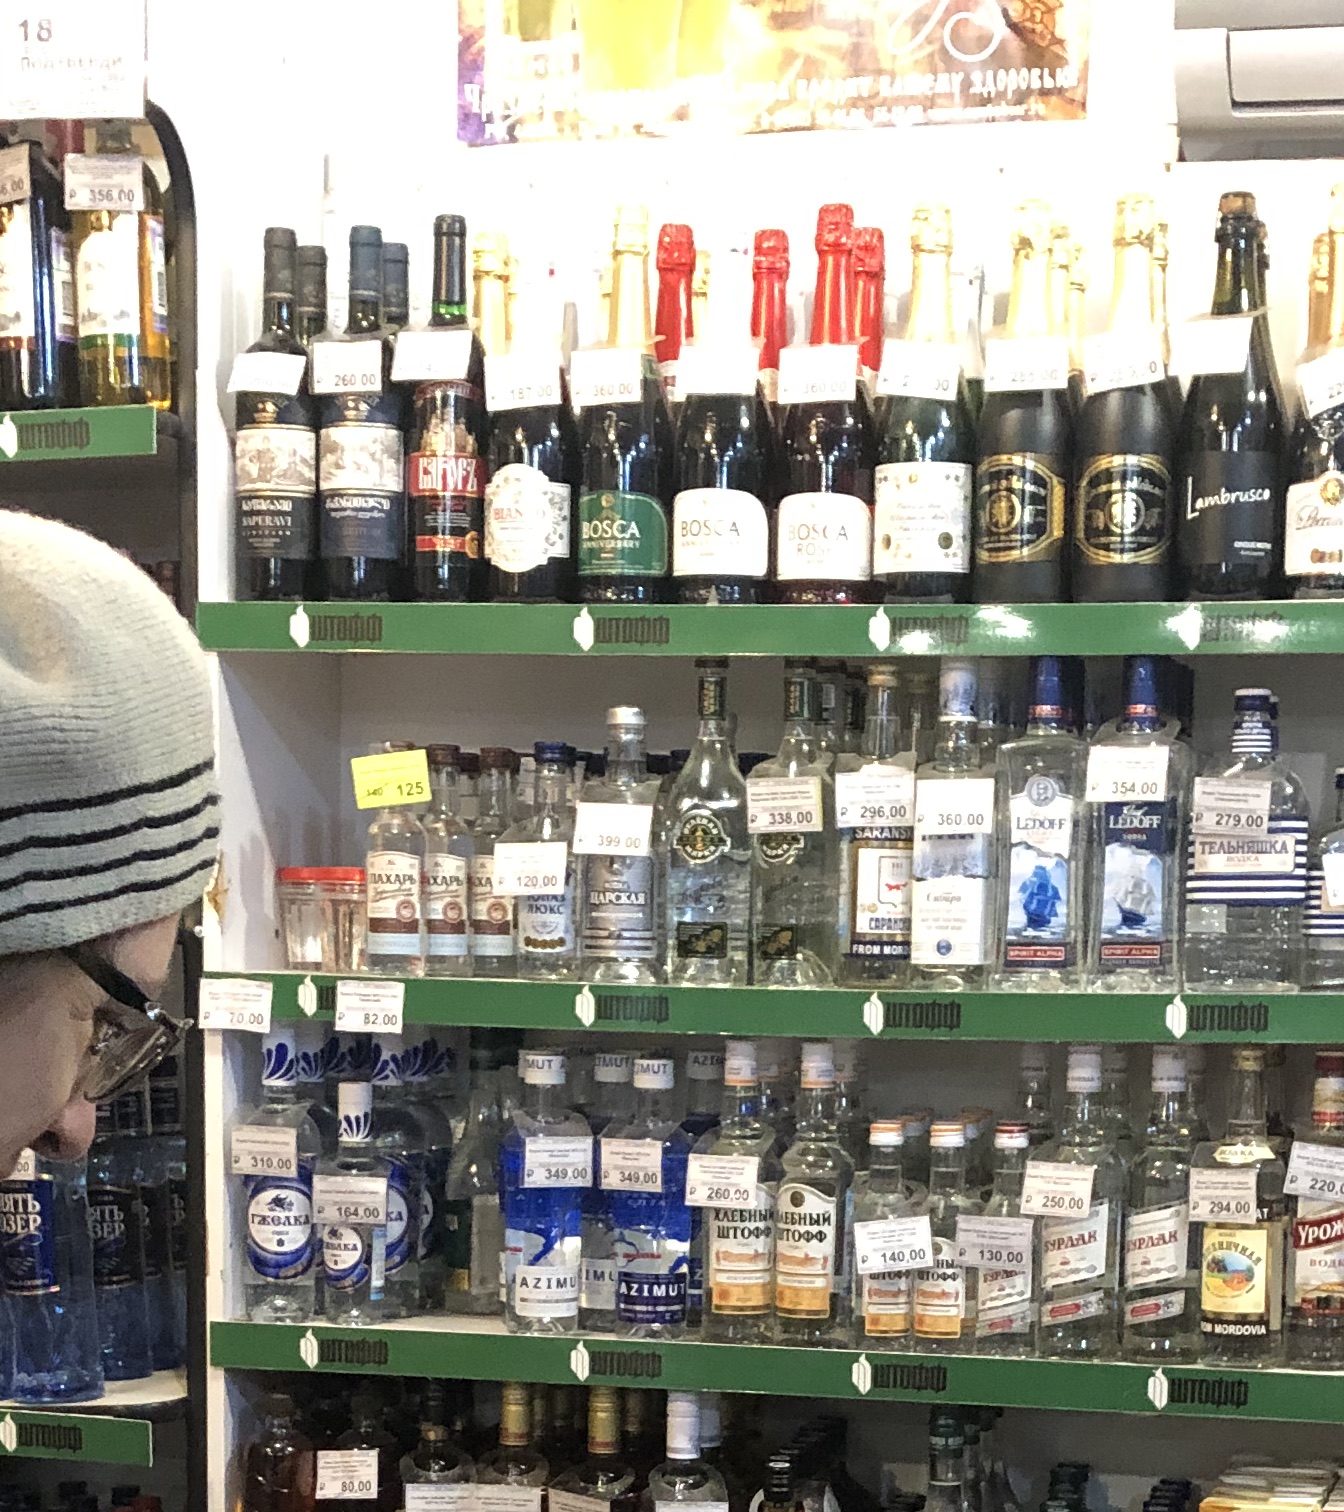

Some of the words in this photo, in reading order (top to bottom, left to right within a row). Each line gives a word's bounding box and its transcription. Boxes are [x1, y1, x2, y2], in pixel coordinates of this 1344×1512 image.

[1185, 476, 1270, 520] Lambrusco
[581, 520, 641, 539] BOSCA
[396, 782, 425, 797] 125
[1108, 814, 1161, 829] LEDOFF
[1199, 840, 1289, 855] ТЕЛЬНЯШКА
[589, 891, 646, 905] ЦАРСКАЯ
[881, 944, 909, 956] MOR
[90, 1204, 125, 1222] ЯТЬ
[778, 1210, 832, 1227] ЛЕБНЫЙ
[716, 1225, 773, 1240] ШТОФФ
[520, 1275, 578, 1290] AZIMU
